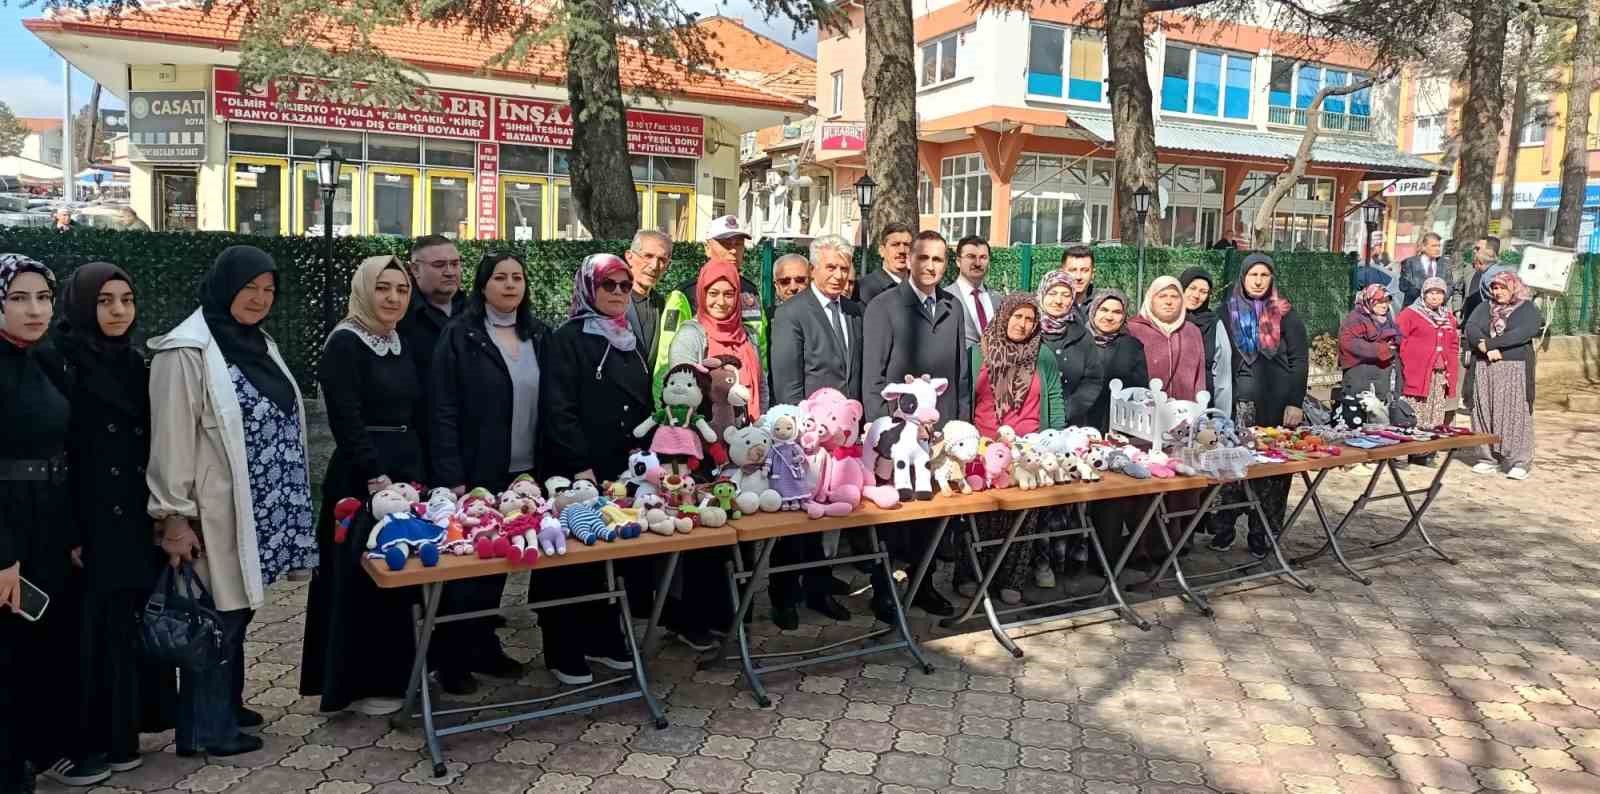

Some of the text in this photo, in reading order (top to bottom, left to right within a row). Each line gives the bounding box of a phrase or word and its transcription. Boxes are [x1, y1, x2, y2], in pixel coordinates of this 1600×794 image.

[152, 99, 205, 116] CASATI
[388, 123, 425, 133] CEPHE
[428, 124, 480, 138] BOYALARI
